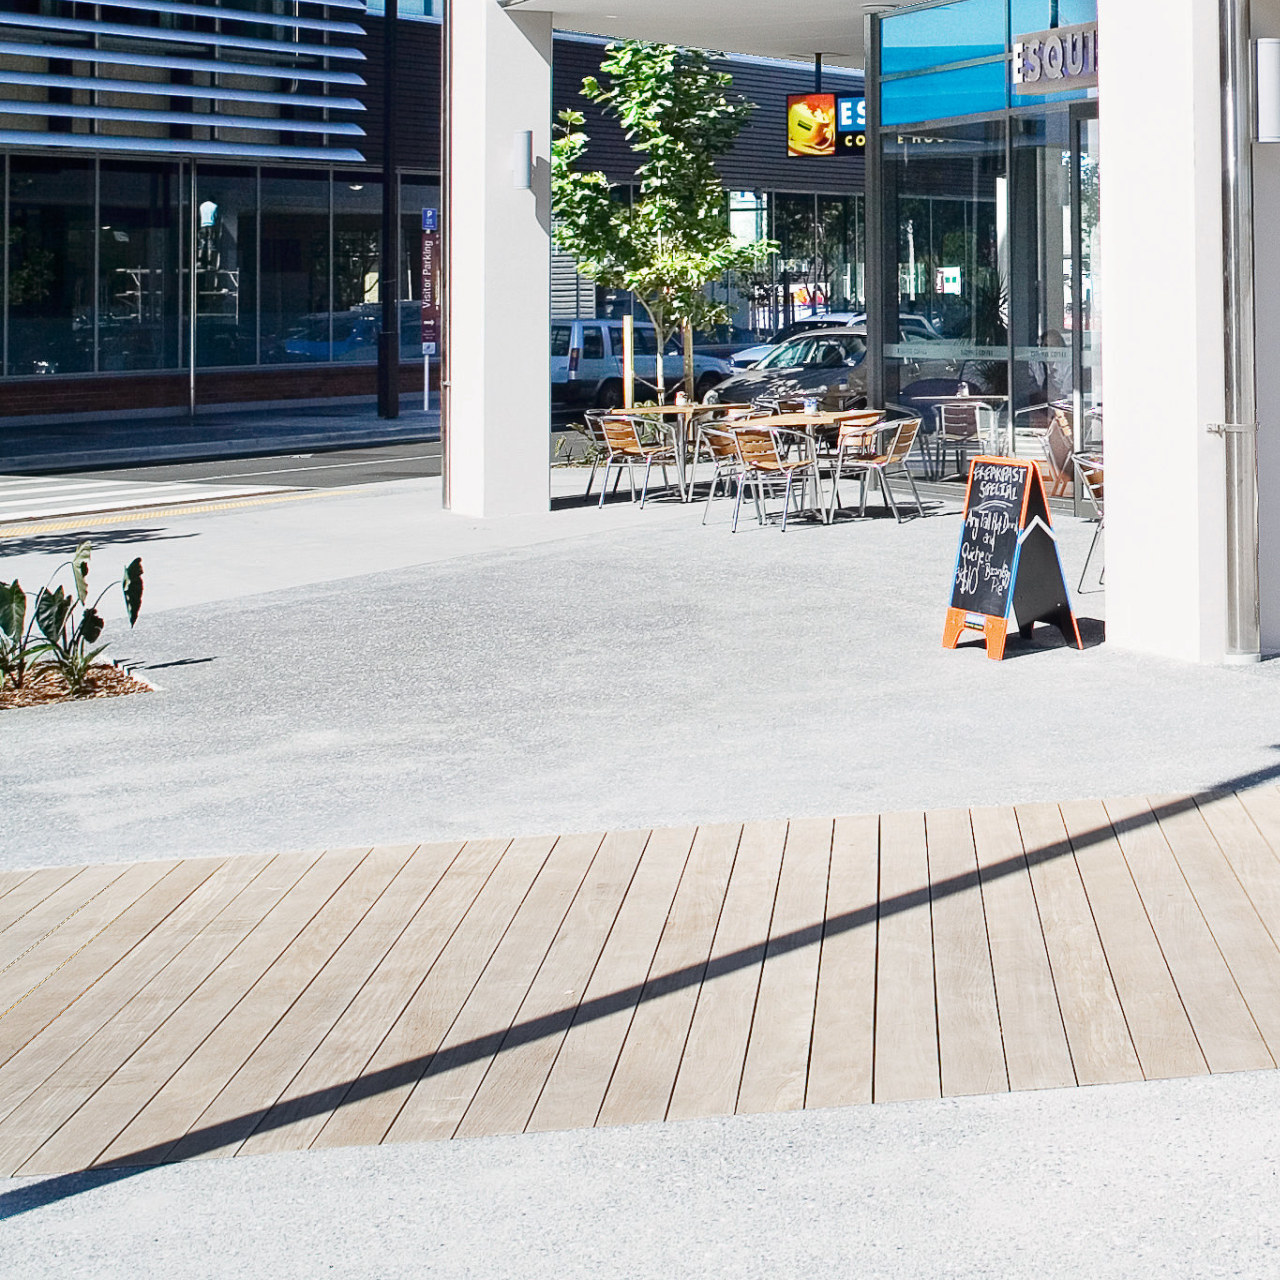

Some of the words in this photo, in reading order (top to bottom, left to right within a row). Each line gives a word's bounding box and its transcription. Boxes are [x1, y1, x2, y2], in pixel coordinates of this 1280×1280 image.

[422, 240, 433, 276] Parking
[422, 278, 431, 309] Visitor
[978, 481, 1018, 500] SPECIAL
[965, 510, 980, 540] Any
[979, 510, 992, 530] Tall
[961, 542, 985, 565] Quiche
[982, 531, 996, 552] and
